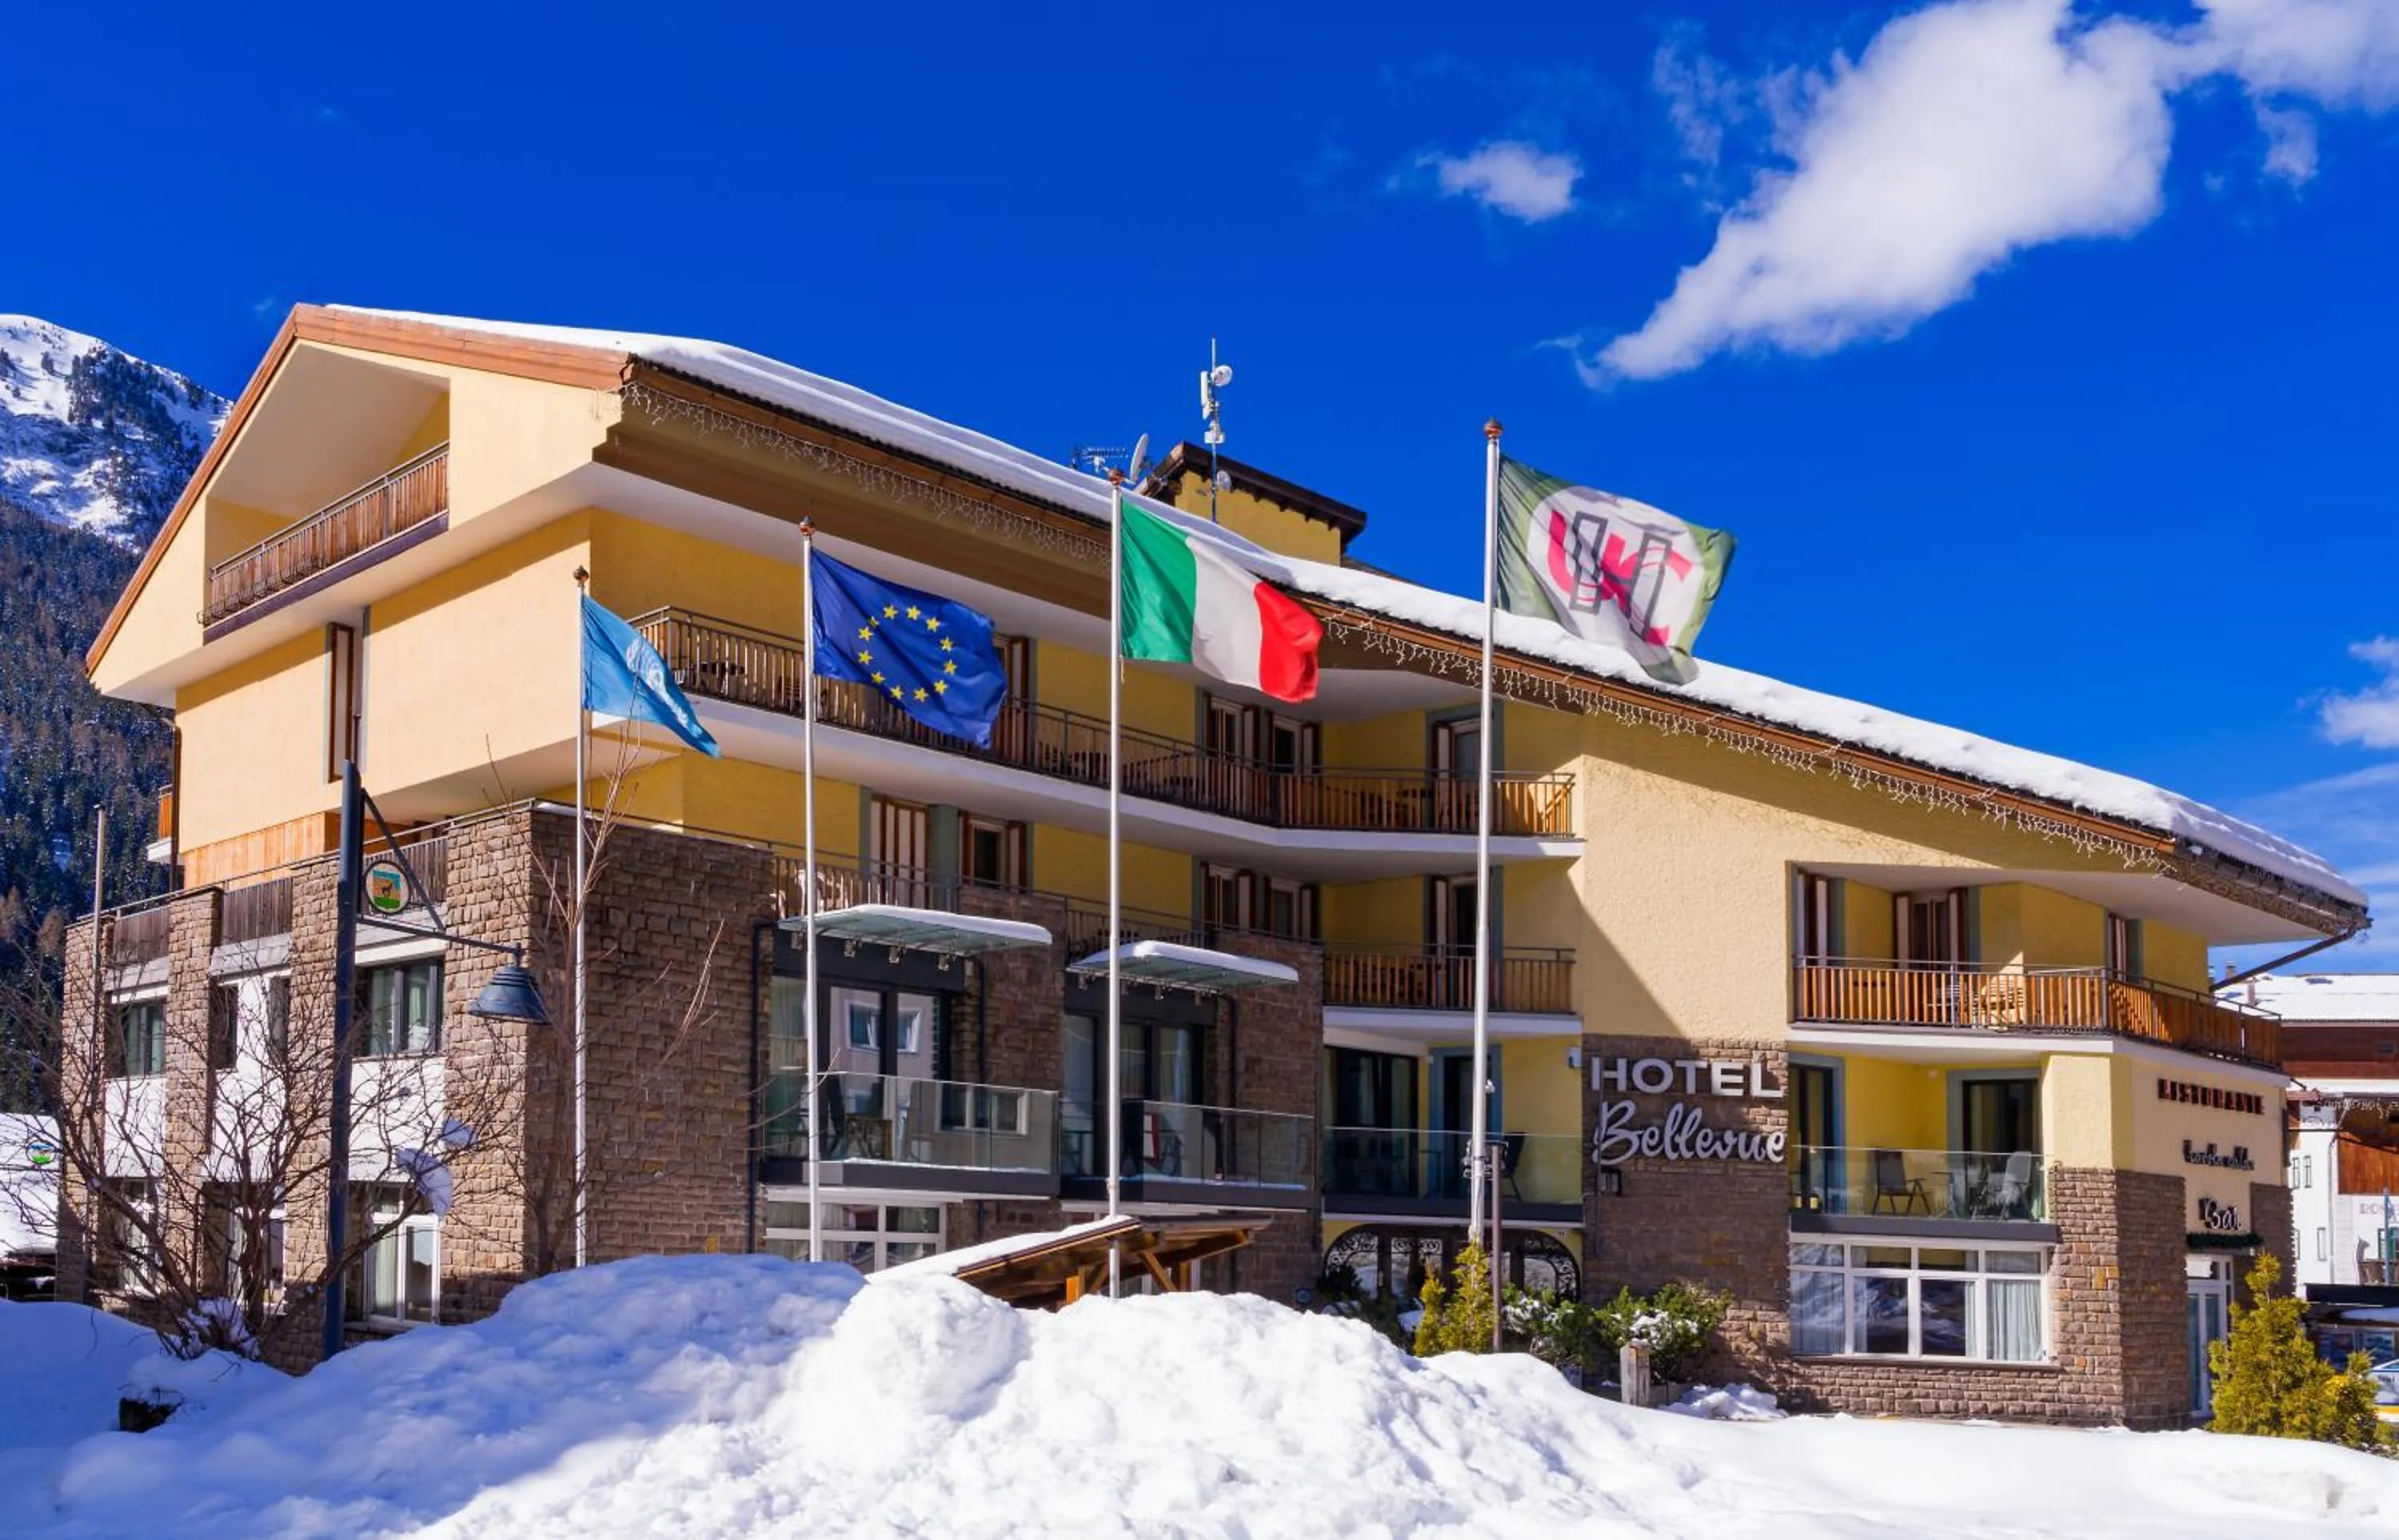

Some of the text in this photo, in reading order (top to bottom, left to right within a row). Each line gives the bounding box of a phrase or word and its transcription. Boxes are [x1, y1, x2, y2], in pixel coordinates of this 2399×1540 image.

[1591, 1056, 1783, 1098] HOTEL
[1591, 1099, 1786, 1165] Bellevue
[2198, 1197, 2242, 1230] Bar
